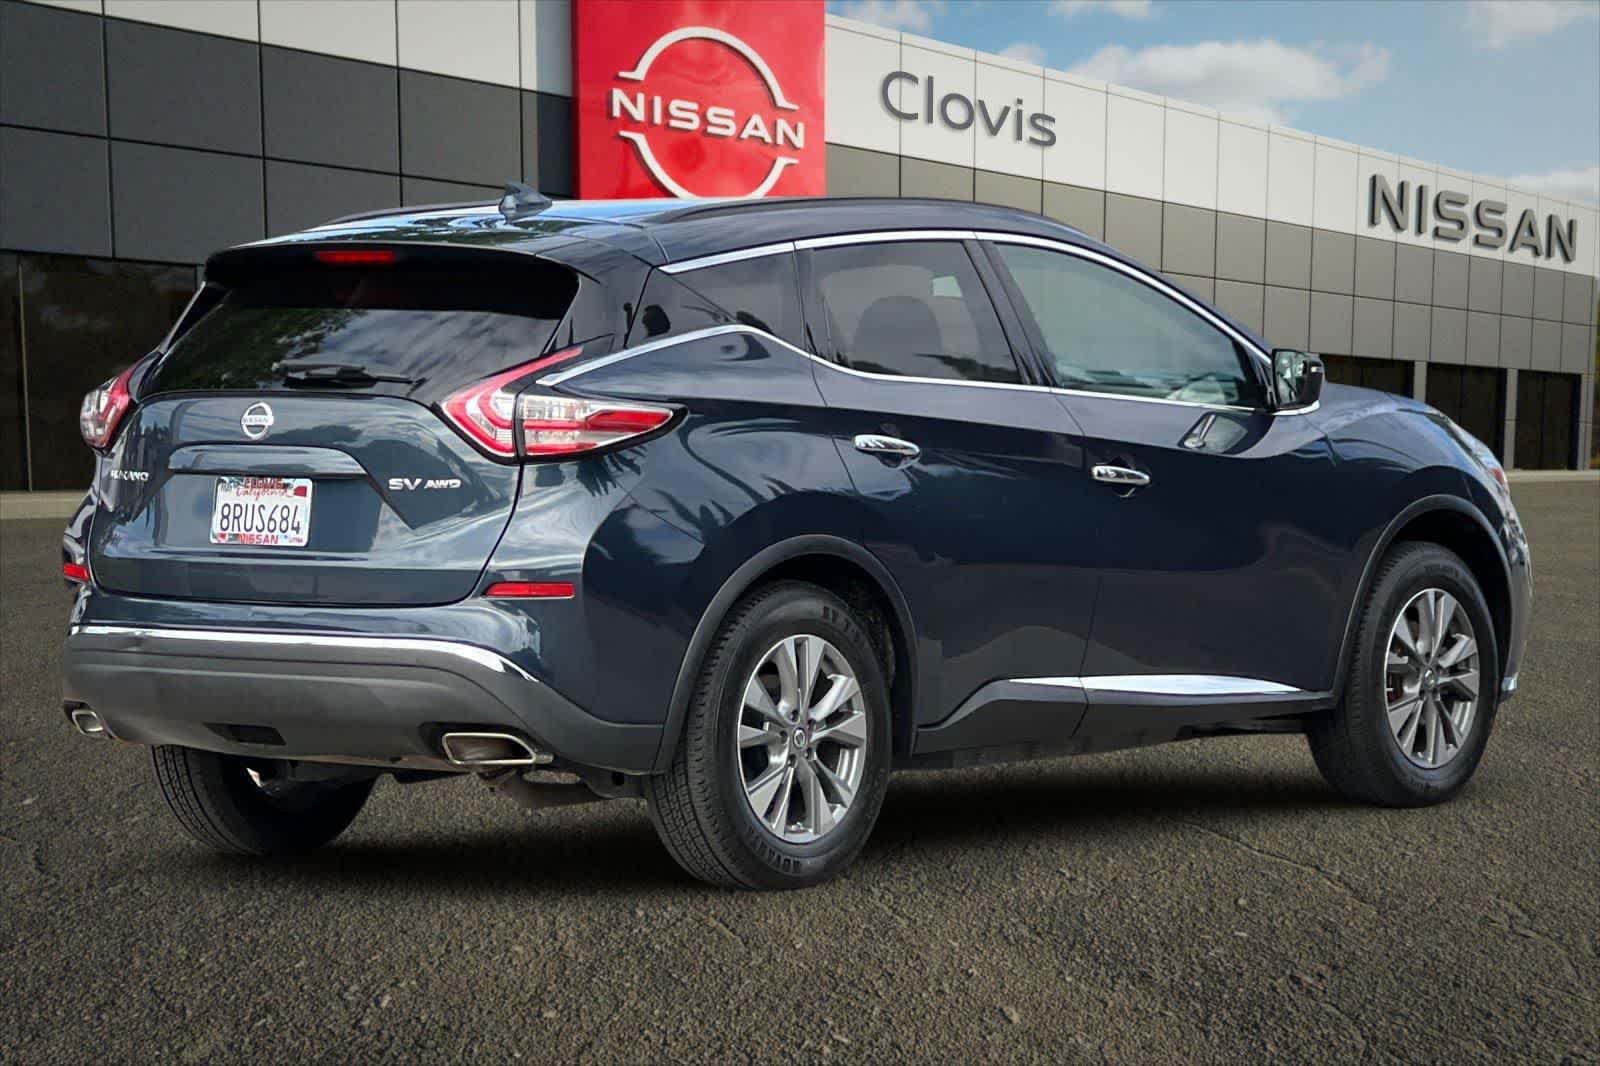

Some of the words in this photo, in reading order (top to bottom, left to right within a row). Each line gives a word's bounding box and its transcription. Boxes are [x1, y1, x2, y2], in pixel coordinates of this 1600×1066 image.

[609, 88, 805, 149] NISSAN
[881, 71, 1056, 147] Clovis
[1368, 173, 1577, 263] NISSAN
[388, 478, 422, 490] SV
[424, 479, 461, 489] AWD
[219, 503, 301, 534] 8RUS684
[240, 534, 279, 544] NISSAN
